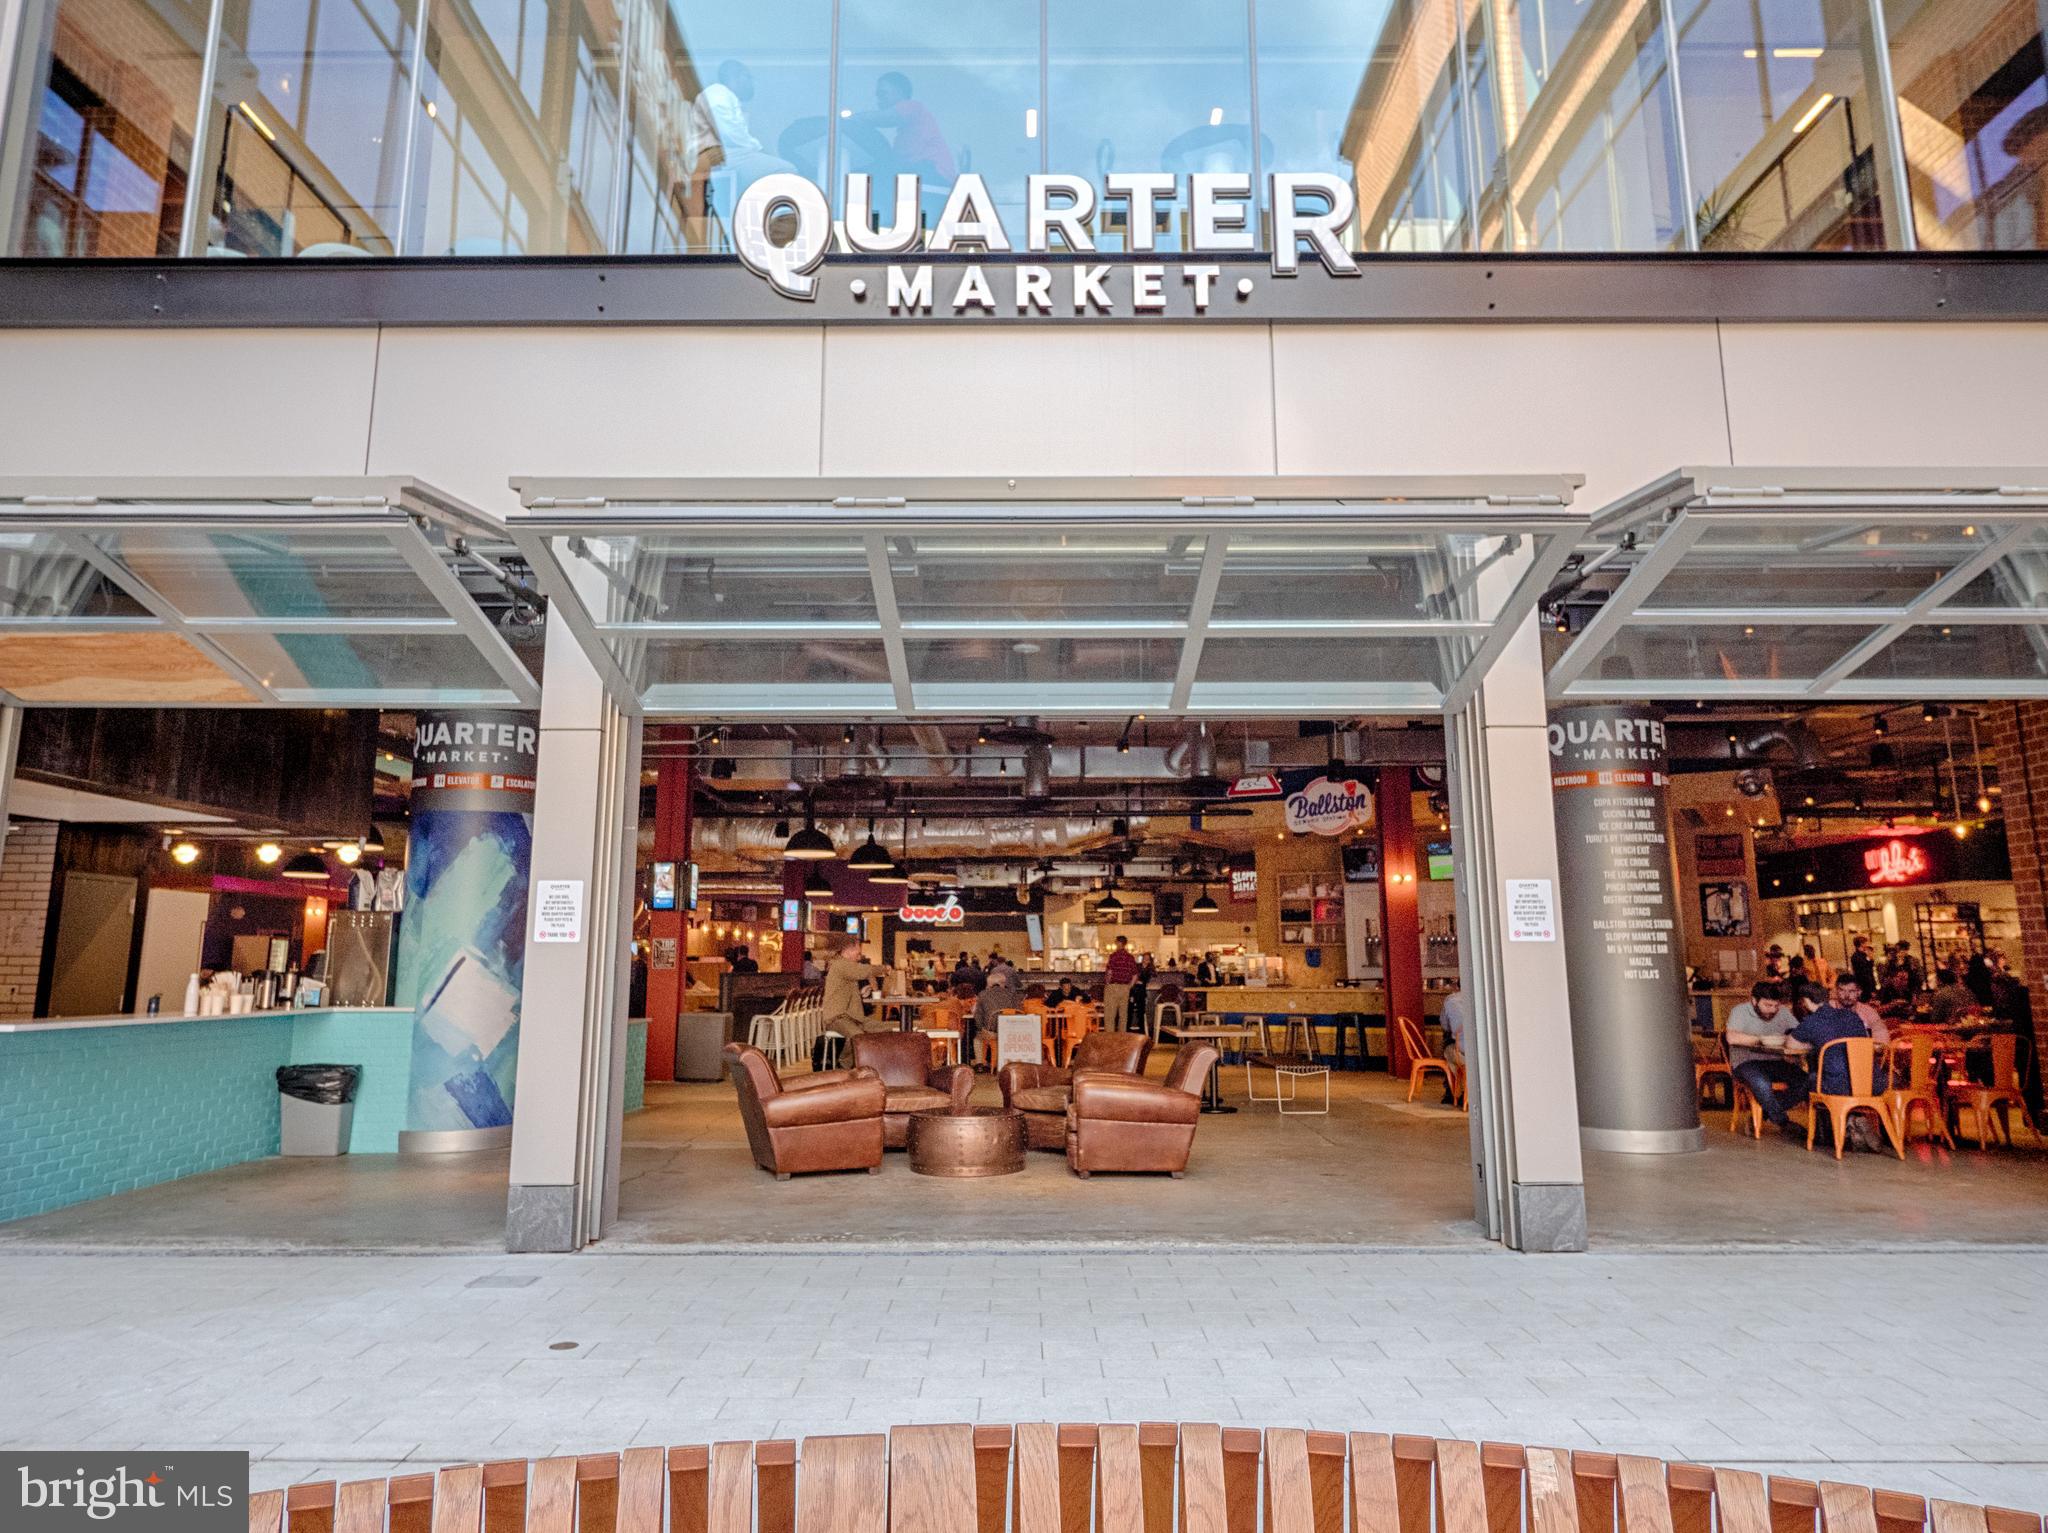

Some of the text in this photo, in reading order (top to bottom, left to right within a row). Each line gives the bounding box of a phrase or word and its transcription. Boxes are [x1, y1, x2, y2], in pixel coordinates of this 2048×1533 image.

[734, 172, 1361, 300] QUARTER
[887, 264, 1220, 312] MARKET
[427, 750, 500, 763] MARKET
[1583, 748, 1657, 760] MARKET
[447, 776, 481, 785] ELEVATOR
[1554, 775, 1587, 786] RESTROOM
[1615, 773, 1645, 782] ELEVATOR
[1288, 792, 1366, 818] Ballston
[1604, 871, 1659, 879] THE LOCAL OYSTER
[1593, 920, 1627, 929] BALLSTON
[1605, 932, 1630, 941] SLOPPY
[1632, 932, 1656, 941] MAMA'S
[1633, 944, 1656, 953] NOODLE
[1624, 969, 1637, 979] HOT
